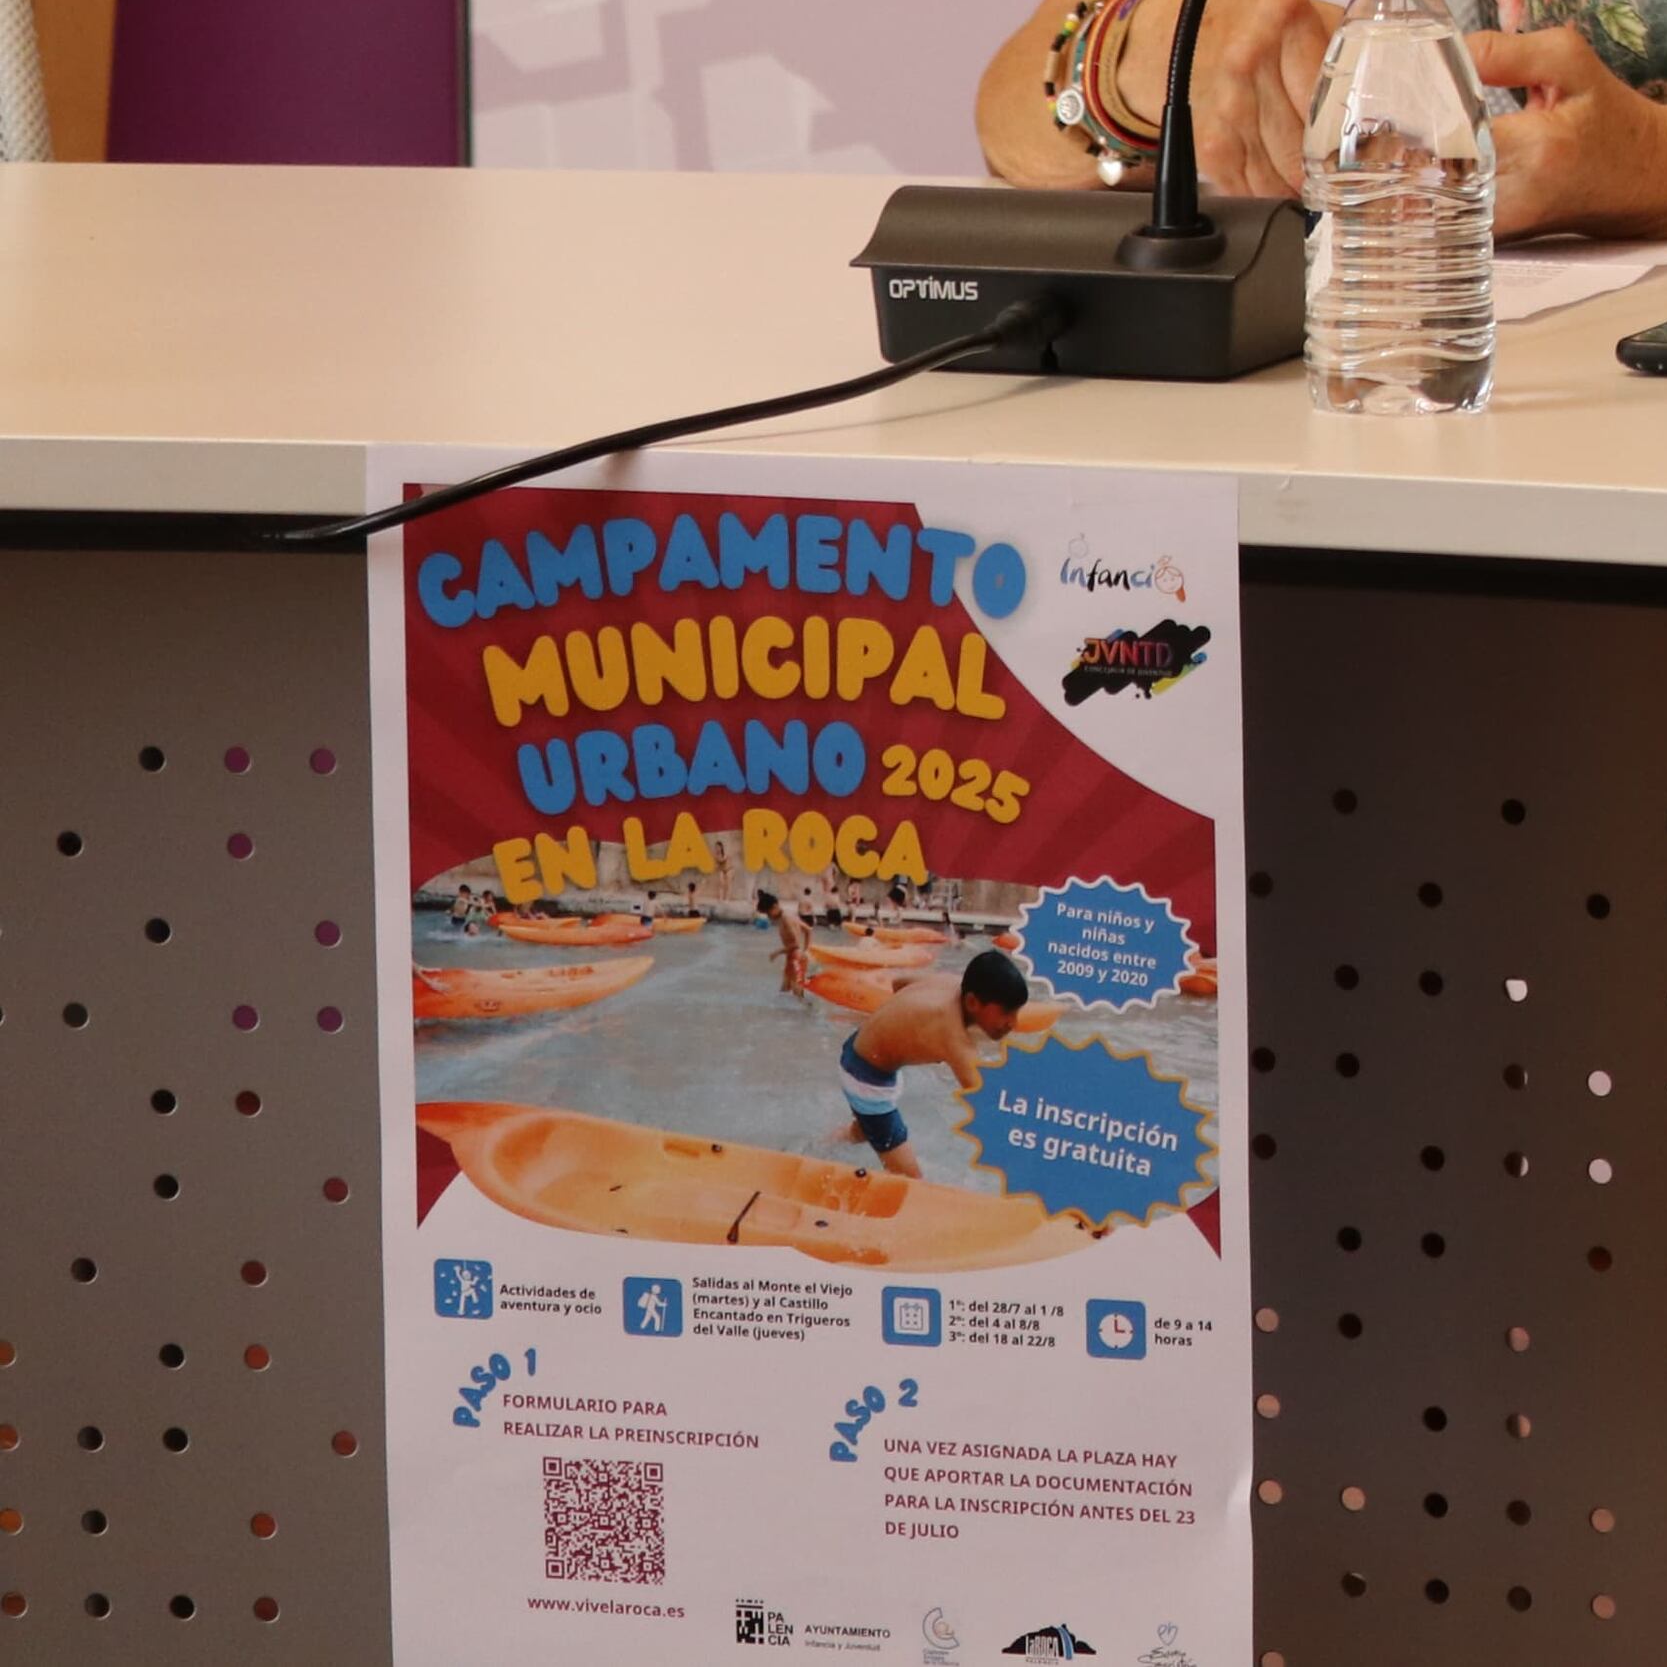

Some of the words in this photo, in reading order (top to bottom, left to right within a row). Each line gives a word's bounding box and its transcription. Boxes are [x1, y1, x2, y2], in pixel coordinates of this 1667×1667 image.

[418, 512, 1027, 628] CAMPAMENTO
[1081, 638, 1172, 667] JVNTD
[483, 615, 1006, 727] MUNICIPAL
[517, 719, 866, 815] URBANO
[881, 744, 1030, 824] 2025
[493, 825, 596, 905] EN
[622, 811, 716, 881] LA
[742, 807, 927, 886] ROCA
[1056, 902, 1093, 922] Para
[1097, 908, 1141, 928] niños
[1145, 918, 1155, 932] y
[1082, 925, 1125, 945] niñas
[1048, 940, 1109, 961] nacidos
[1113, 951, 1157, 969] entre
[1057, 960, 1094, 978] 2009
[1098, 967, 1107, 983] y
[1111, 969, 1148, 986] 2020
[998, 1090, 1028, 1116] La
[1035, 1097, 1179, 1151] inscripción
[1007, 1127, 1037, 1149] es
[1042, 1137, 1151, 1177] gratuita
[500, 1284, 577, 1300] Actividades
[579, 1287, 596, 1300] de
[692, 1277, 739, 1290] Salidas
[742, 1279, 754, 1291] al
[758, 1280, 801, 1294] Monte
[805, 1282, 817, 1293] el
[820, 1283, 852, 1298] Viejo
[500, 1300, 560, 1313] aventura
[563, 1304, 572, 1316] y
[574, 1302, 602, 1315] ocio
[692, 1293, 749, 1308] (martes)
[753, 1297, 760, 1308] y
[763, 1295, 775, 1307] al
[779, 1296, 828, 1310] Castillo
[969, 1301, 988, 1313] del
[992, 1302, 1020, 1315] 28/7
[1024, 1303, 1036, 1315] al
[693, 1308, 763, 1322] Encantado
[767, 1313, 783, 1323] en
[787, 1312, 850, 1327] Trigueros
[969, 1317, 988, 1328] del
[992, 1318, 1000, 1328] 4
[1004, 1318, 1016, 1330] al
[1020, 1319, 1040, 1331] 8/8
[1154, 1318, 1170, 1329] de
[1174, 1319, 1182, 1330] 9
[1185, 1322, 1193, 1331] a
[1198, 1320, 1212, 1332] 14
[693, 1324, 713, 1335] del
[717, 1324, 749, 1337] Valle
[753, 1327, 805, 1342] (jueves)
[969, 1332, 988, 1343] del
[994, 1333, 1007, 1344] 18
[1011, 1334, 1023, 1346] al
[1027, 1335, 1056, 1347] 22/8
[1154, 1335, 1192, 1346] horas
[453, 1353, 511, 1428] PASO
[523, 1347, 537, 1376] 1
[503, 1394, 617, 1414] FORMULARIO
[623, 1400, 667, 1416] PARA
[829, 1385, 886, 1463] PASO
[898, 1378, 919, 1407] 2
[503, 1421, 584, 1439] REALIZAR
[588, 1425, 610, 1441] LA
[615, 1426, 760, 1449] PREINSCRIPCIÓN
[884, 1438, 922, 1454] UNA
[926, 1441, 957, 1456] VEZ
[961, 1443, 1052, 1461] ASIGNADA
[1057, 1448, 1078, 1463] LA
[1083, 1450, 1137, 1466] PLAZA
[1142, 1453, 1177, 1469] HAY
[884, 1466, 919, 1483] QUE
[924, 1468, 1004, 1486] APORTAR
[1010, 1473, 1030, 1487] LA
[1036, 1474, 1193, 1497] DOCUMENTACIÓN
[884, 1494, 929, 1509] PARA
[935, 1497, 955, 1511] LA
[960, 1498, 1074, 1518] INSCRIPCIÓN
[1080, 1506, 1134, 1521] ANTES
[1139, 1508, 1171, 1523] DEL
[1176, 1510, 1195, 1525] 23
[885, 1521, 906, 1535] DE
[910, 1522, 959, 1539] JULIO
[527, 1597, 685, 1618] www.vivelaroca.es
[768, 1611, 784, 1622] PA
[768, 1623, 793, 1635] LEN
[804, 1624, 890, 1639] AYUNTAMIENTO
[768, 1635, 790, 1646] CIA
